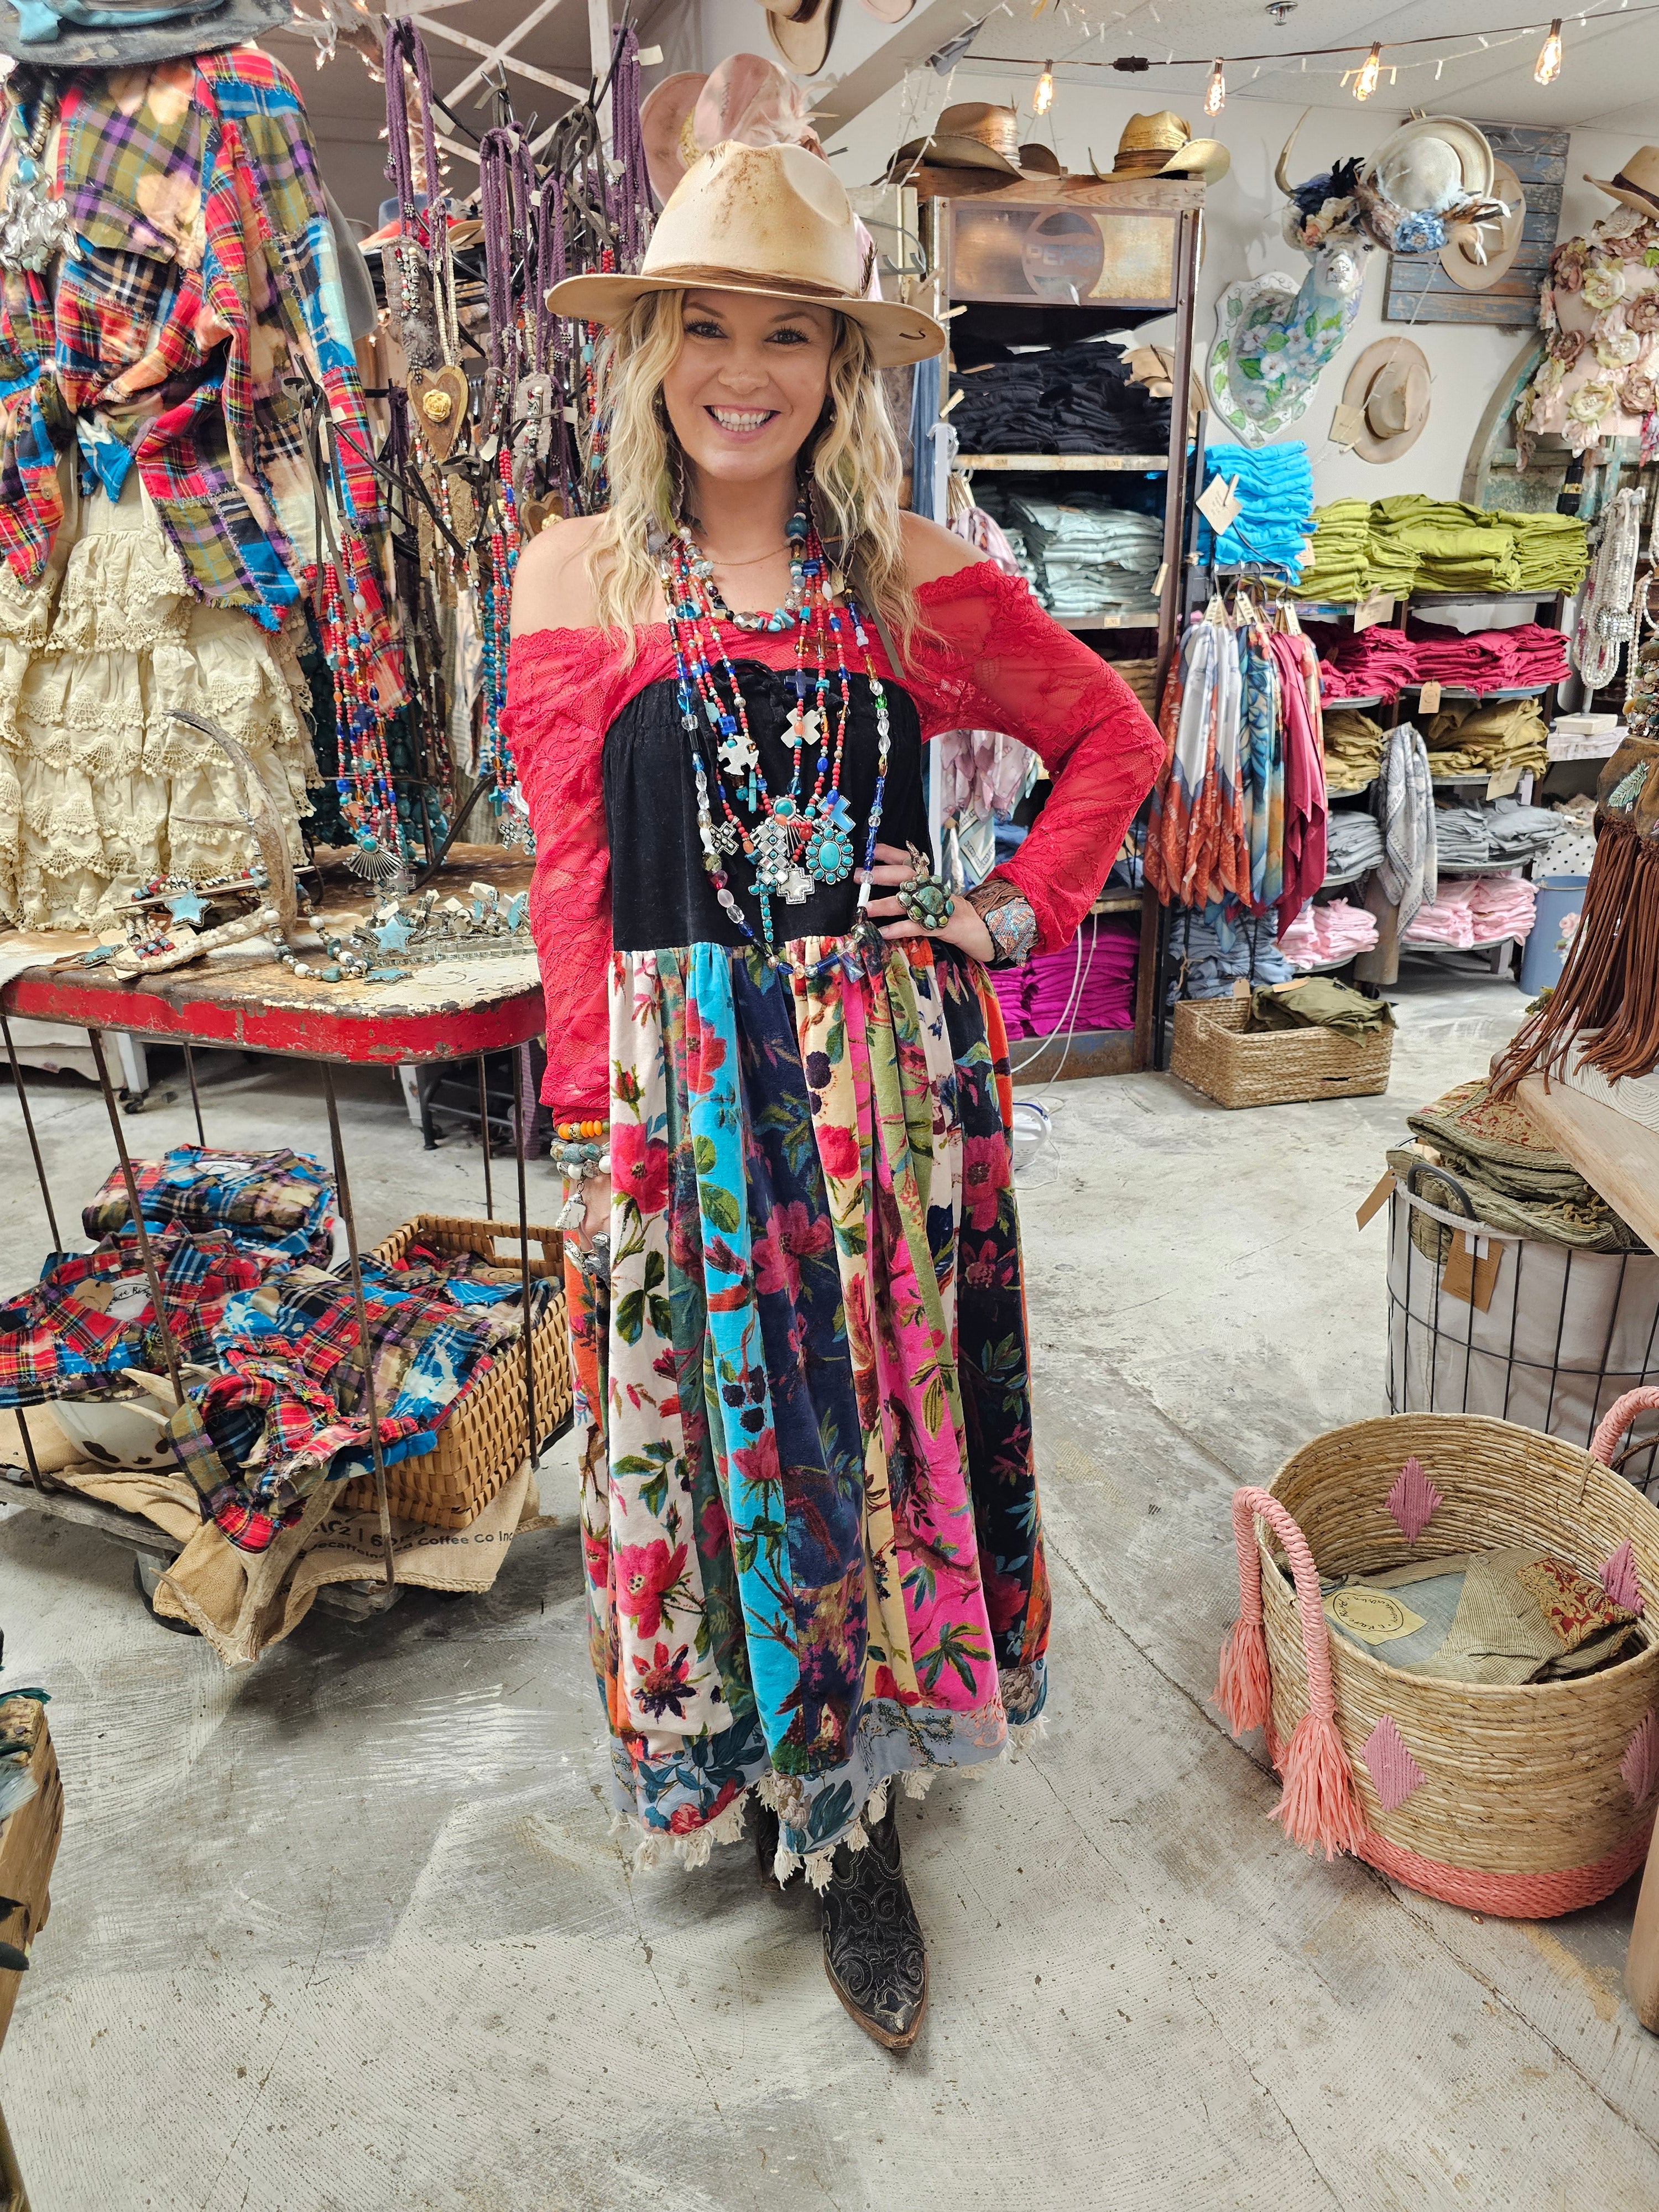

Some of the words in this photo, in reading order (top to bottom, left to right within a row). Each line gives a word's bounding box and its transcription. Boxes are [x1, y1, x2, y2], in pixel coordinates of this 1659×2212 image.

[1026, 243, 1100, 266] PEPSI
[418, 1535, 469, 1546] Coffee
[474, 1533, 494, 1543] Co
